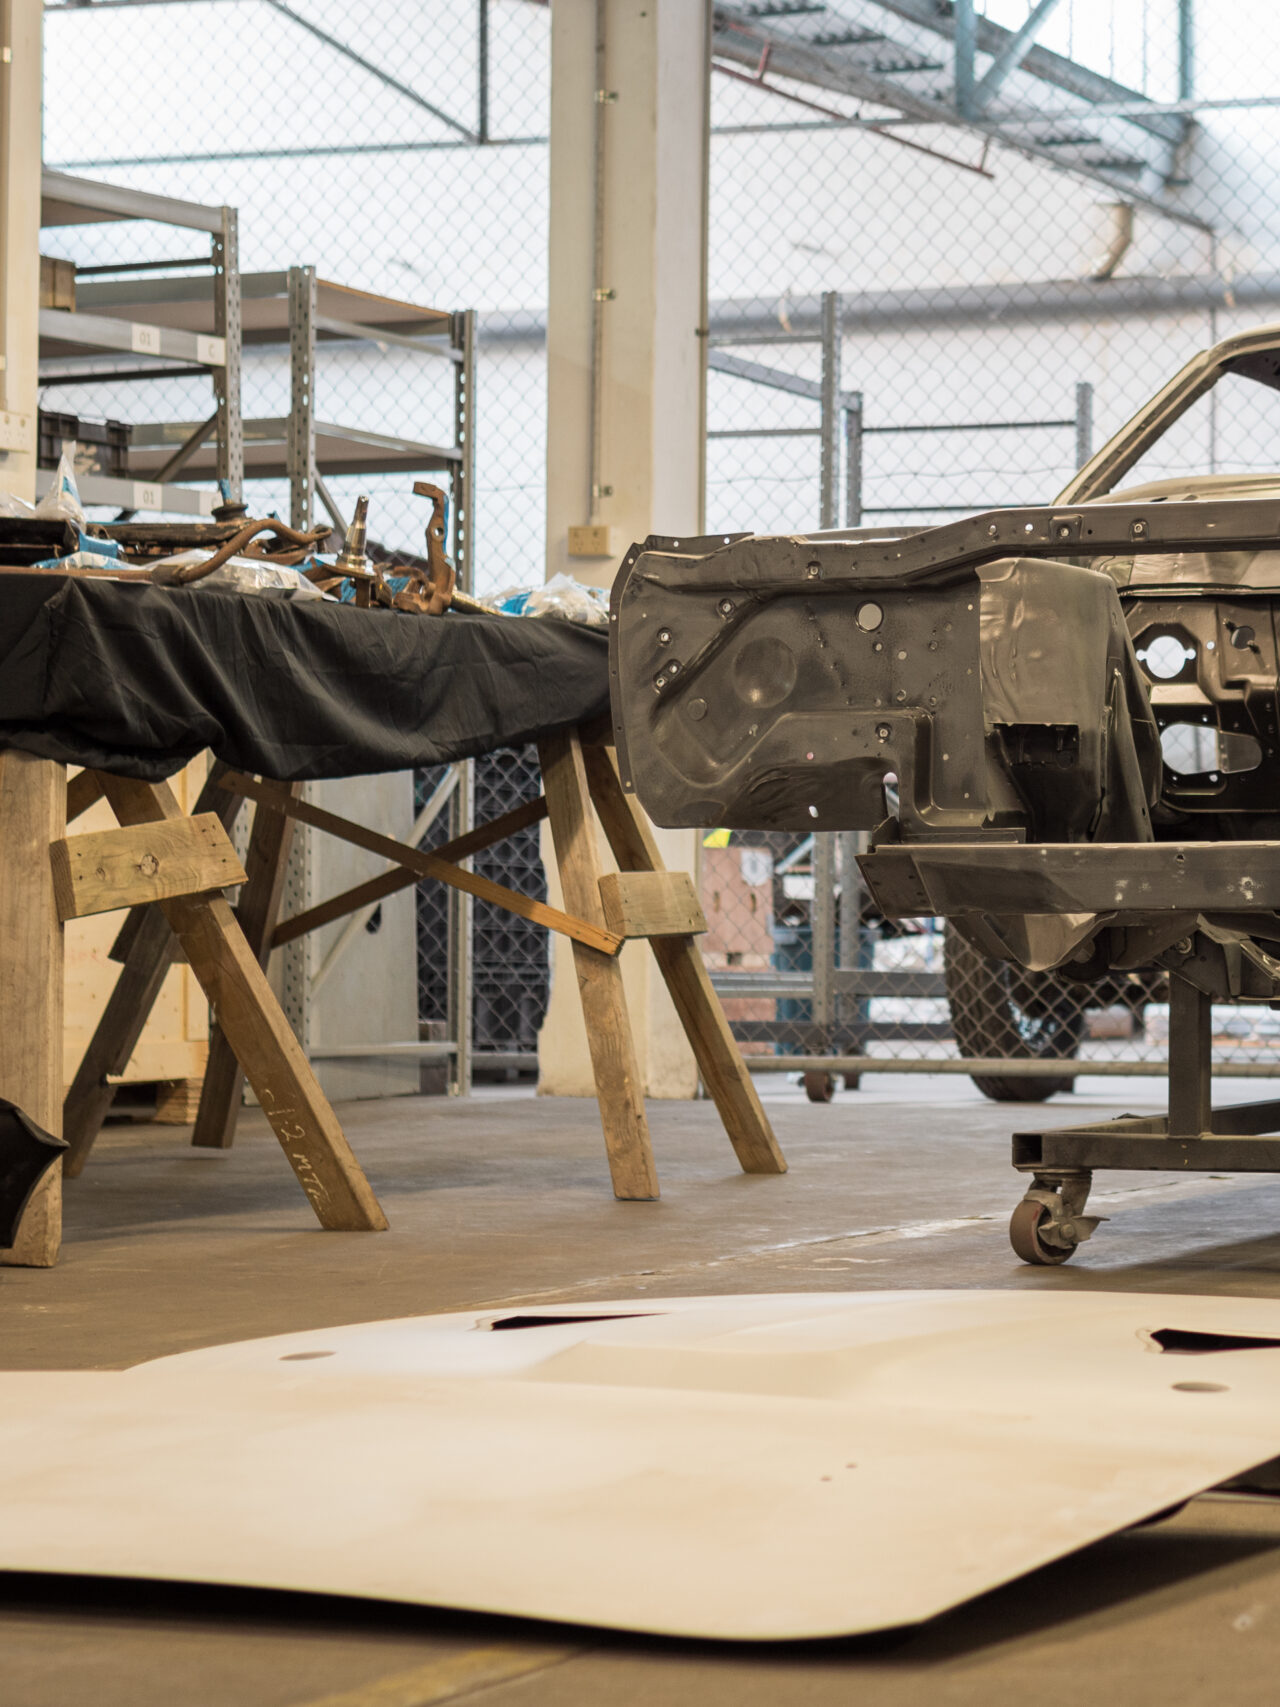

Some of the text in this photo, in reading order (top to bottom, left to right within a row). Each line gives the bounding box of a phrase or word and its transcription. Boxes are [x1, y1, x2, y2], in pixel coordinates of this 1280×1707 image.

[139, 331, 152, 347] 01
[208, 343, 216, 359] C
[143, 490, 155, 505] 01
